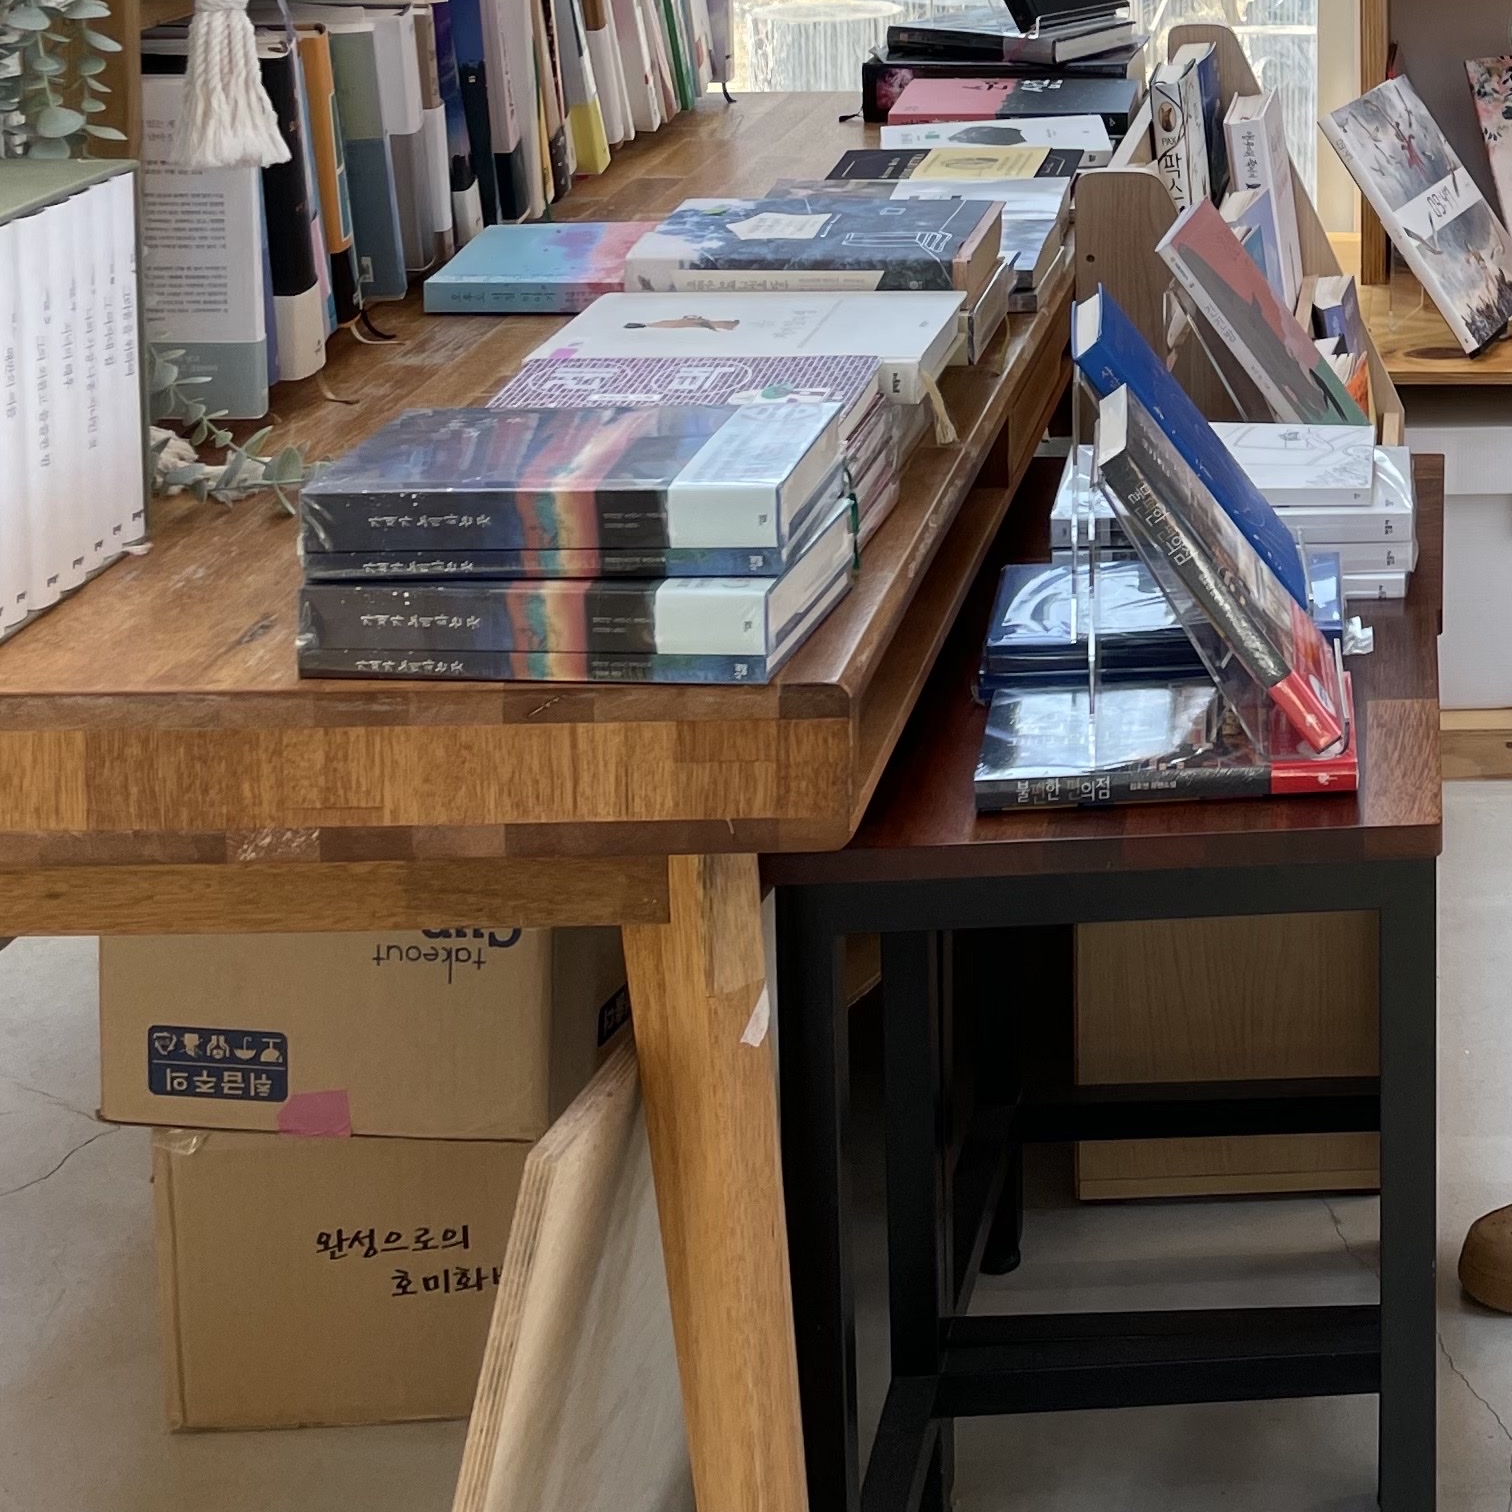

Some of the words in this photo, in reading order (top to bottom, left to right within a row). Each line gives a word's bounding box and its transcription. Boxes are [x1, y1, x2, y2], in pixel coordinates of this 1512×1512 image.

[686, 279, 716, 290] 여름은
[717, 279, 736, 290] 오래
[739, 279, 768, 290] 그곳에
[769, 279, 789, 290] 남아
[1127, 483, 1170, 528] 불편한
[1156, 525, 1199, 566] 편의점
[1014, 780, 1061, 806] 불편한
[1066, 776, 1111, 803] 편의점
[372, 944, 487, 984] takeout
[166, 1067, 273, 1097] 취급주의
[315, 1225, 471, 1260] 완성으로의
